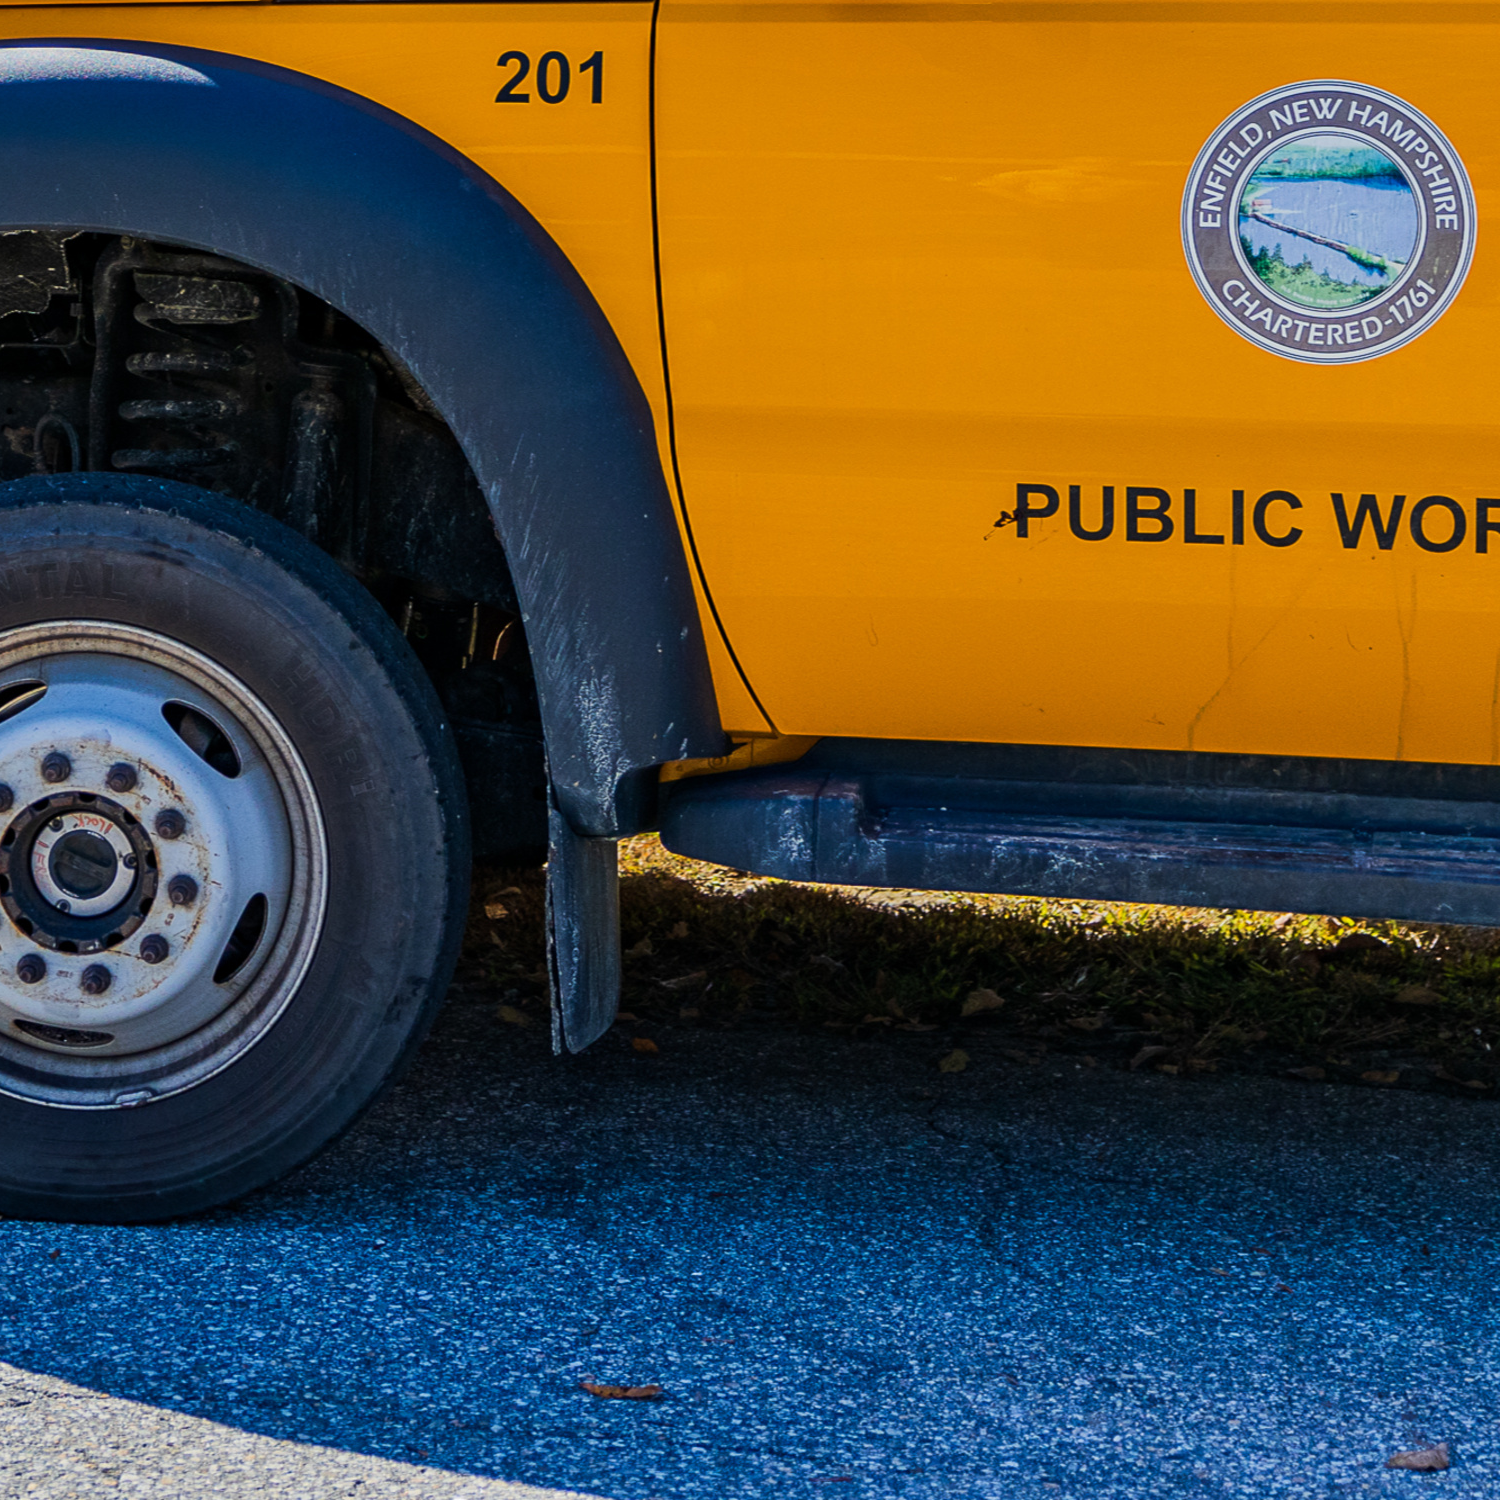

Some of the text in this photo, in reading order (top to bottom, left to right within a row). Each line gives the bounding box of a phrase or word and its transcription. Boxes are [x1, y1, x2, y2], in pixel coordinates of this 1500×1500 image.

[494, 50, 604, 104] 201
[1269, 98, 1343, 130] NEW
[1347, 100, 1459, 231] HAMPSHIRE
[1016, 483, 1304, 547] PUBLIC
